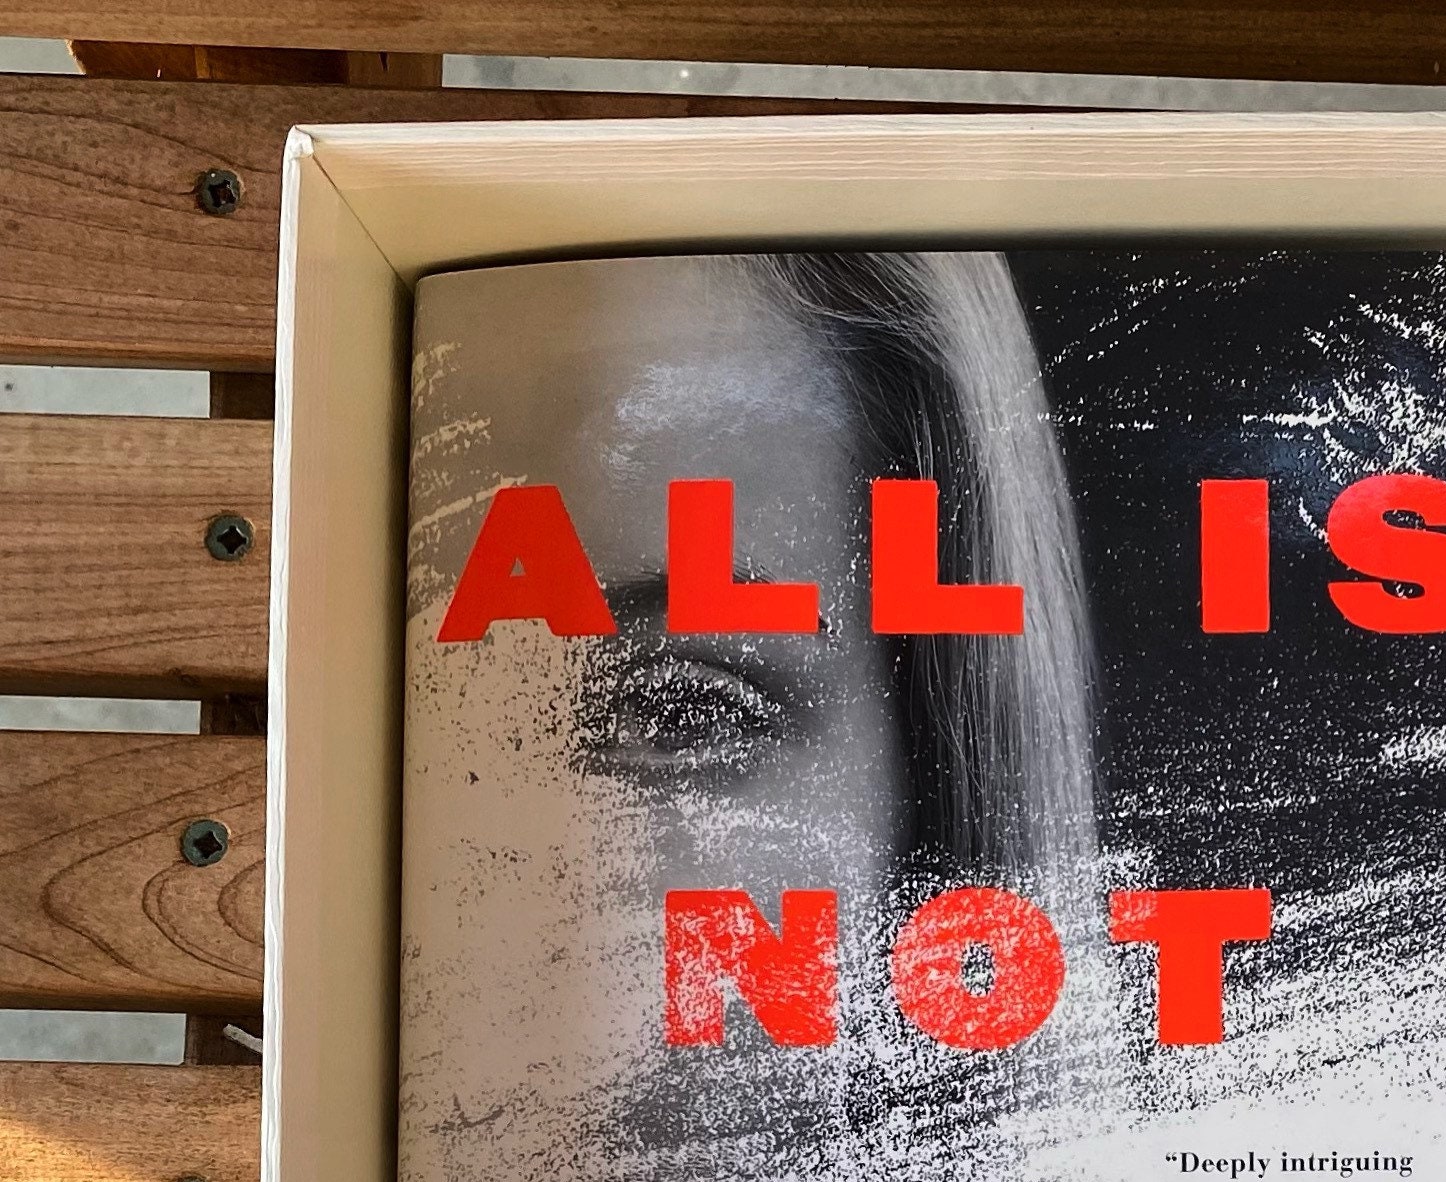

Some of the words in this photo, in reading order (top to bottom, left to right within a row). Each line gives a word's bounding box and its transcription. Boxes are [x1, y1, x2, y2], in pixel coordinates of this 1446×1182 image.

[437, 478, 1024, 641] ALL
[664, 887, 1271, 1050] NOT
[1165, 1152, 1271, 1179] “Deeply
[1281, 1151, 1414, 1178] intriguing
